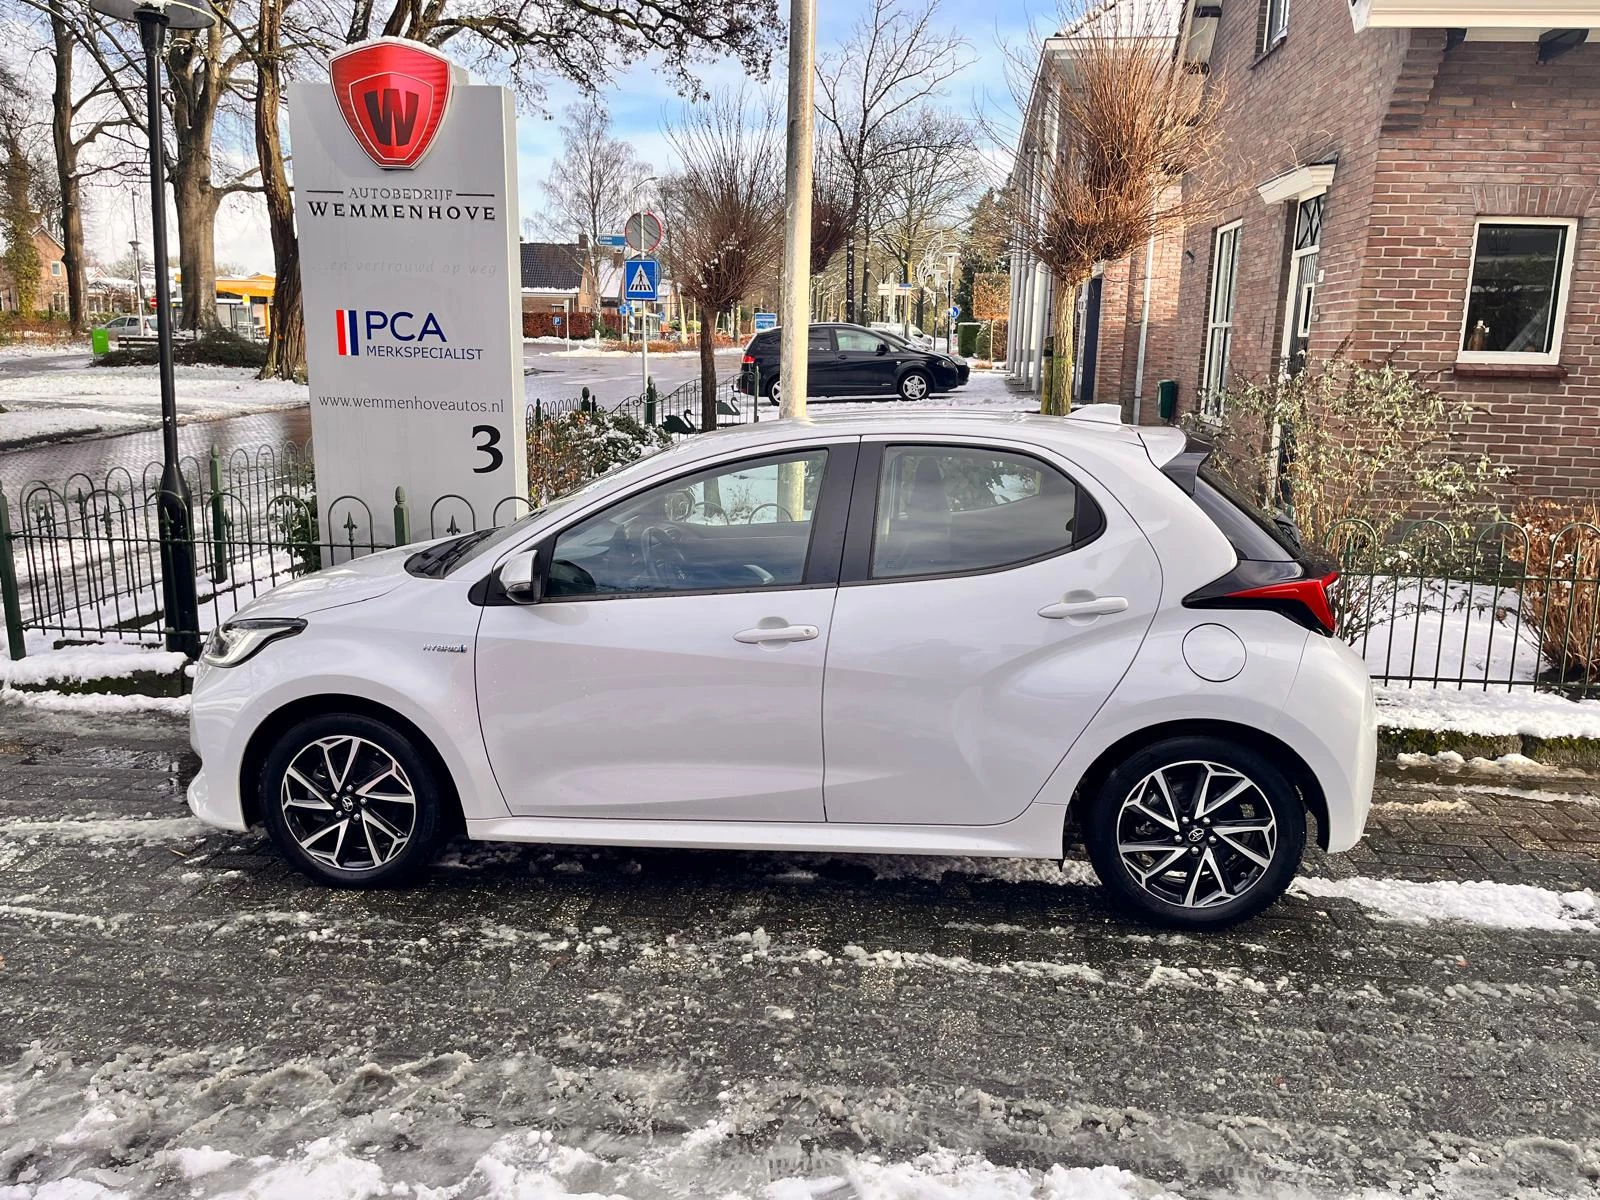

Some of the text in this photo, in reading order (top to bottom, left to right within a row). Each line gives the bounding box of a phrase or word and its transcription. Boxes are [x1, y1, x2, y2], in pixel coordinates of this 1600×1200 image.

[364, 88, 419, 146] W
[349, 187, 453, 201] AUTOBEDRIJF
[307, 201, 496, 221] WEMMENHOVE
[355, 257, 434, 274] vertrouwd
[442, 265, 461, 276] op
[468, 264, 497, 278] weg
[365, 310, 447, 343] PCA
[366, 345, 484, 361] MERKSPECIALIST
[318, 395, 505, 413] www.wemmenhoveautos.nl
[471, 424, 504, 474] 3
